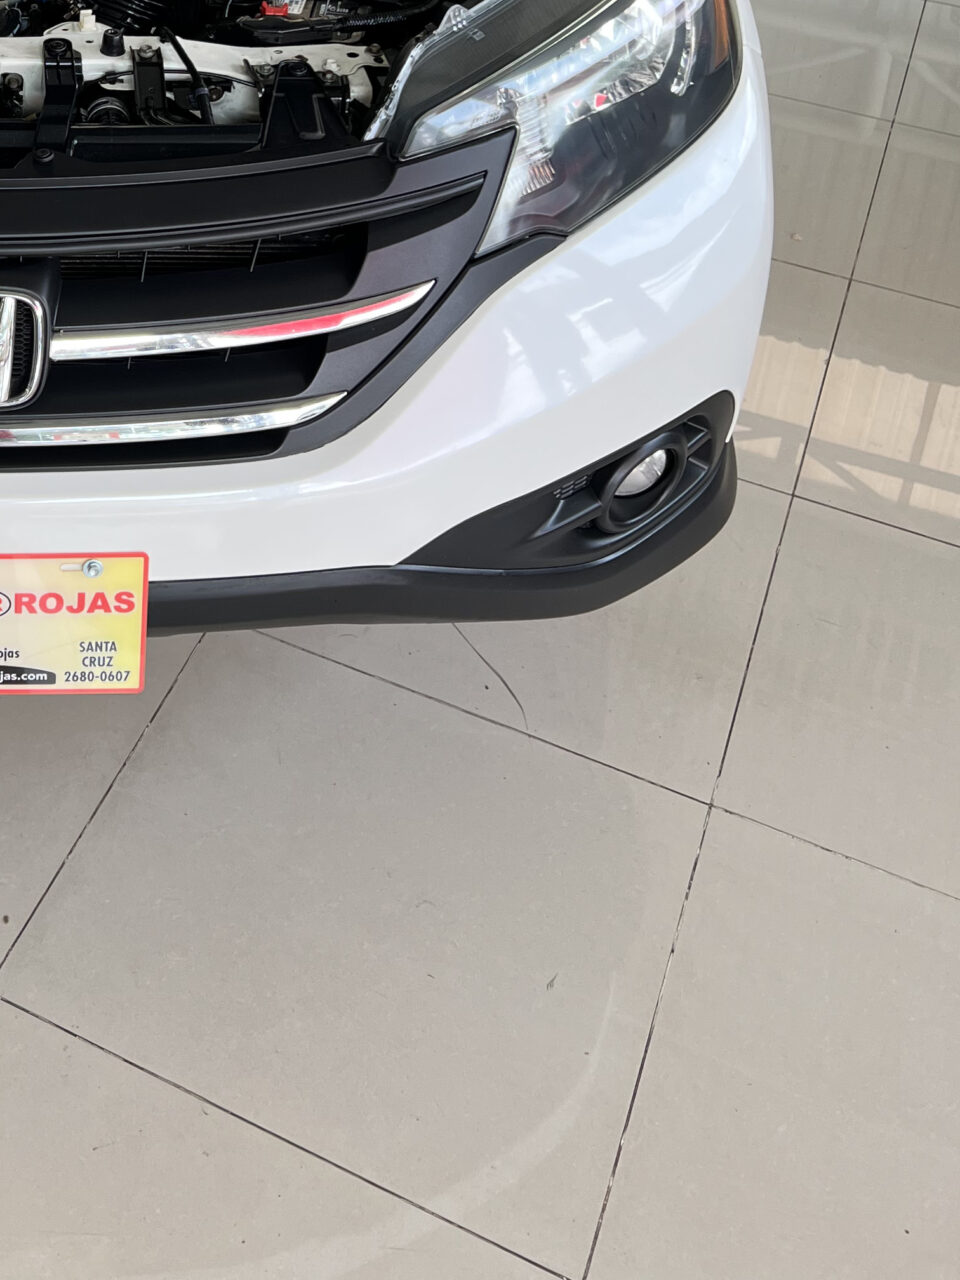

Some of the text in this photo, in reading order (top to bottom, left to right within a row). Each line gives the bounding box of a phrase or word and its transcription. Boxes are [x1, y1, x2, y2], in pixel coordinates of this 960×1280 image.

[14, 591, 136, 614] ROJAS
[79, 641, 117, 652] SANTA
[82, 656, 114, 667] CRUZ
[64, 670, 131, 682] 2680-0607
